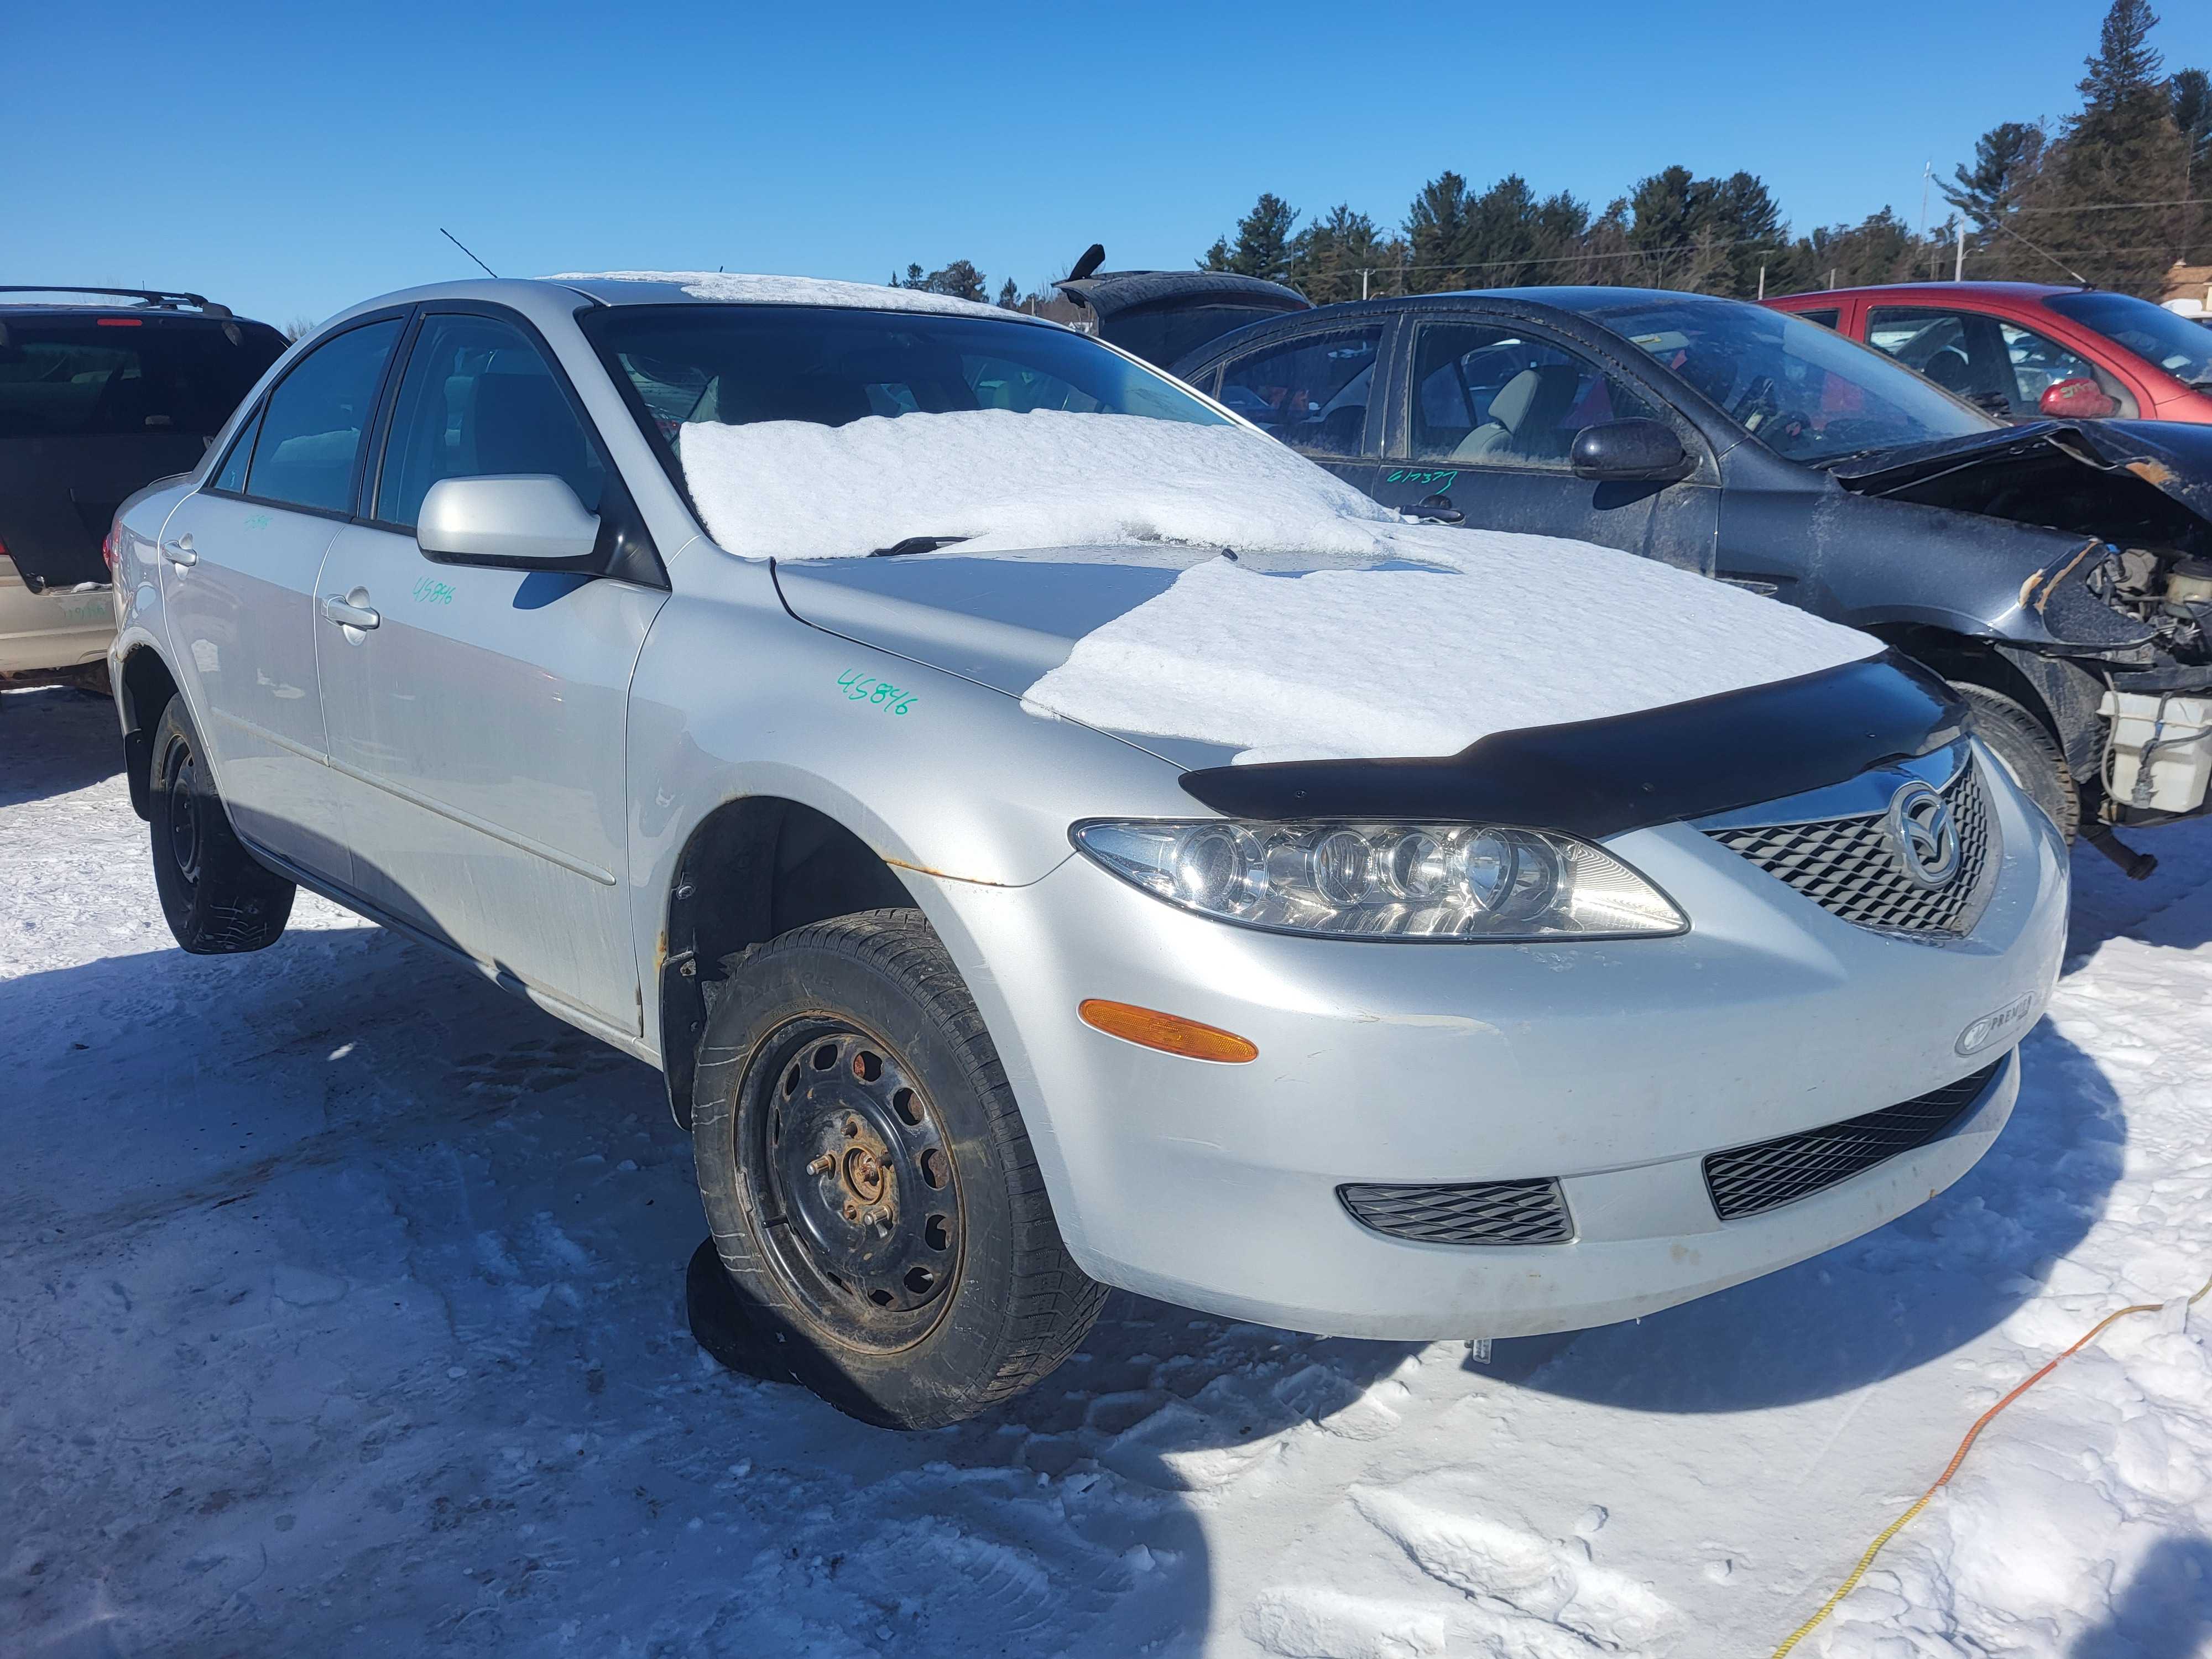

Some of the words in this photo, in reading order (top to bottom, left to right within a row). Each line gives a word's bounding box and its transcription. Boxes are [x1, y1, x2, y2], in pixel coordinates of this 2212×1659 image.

[412, 576, 456, 605] 45846
[837, 668, 919, 716] 45846
[1990, 995, 2032, 1030] PREMIER
